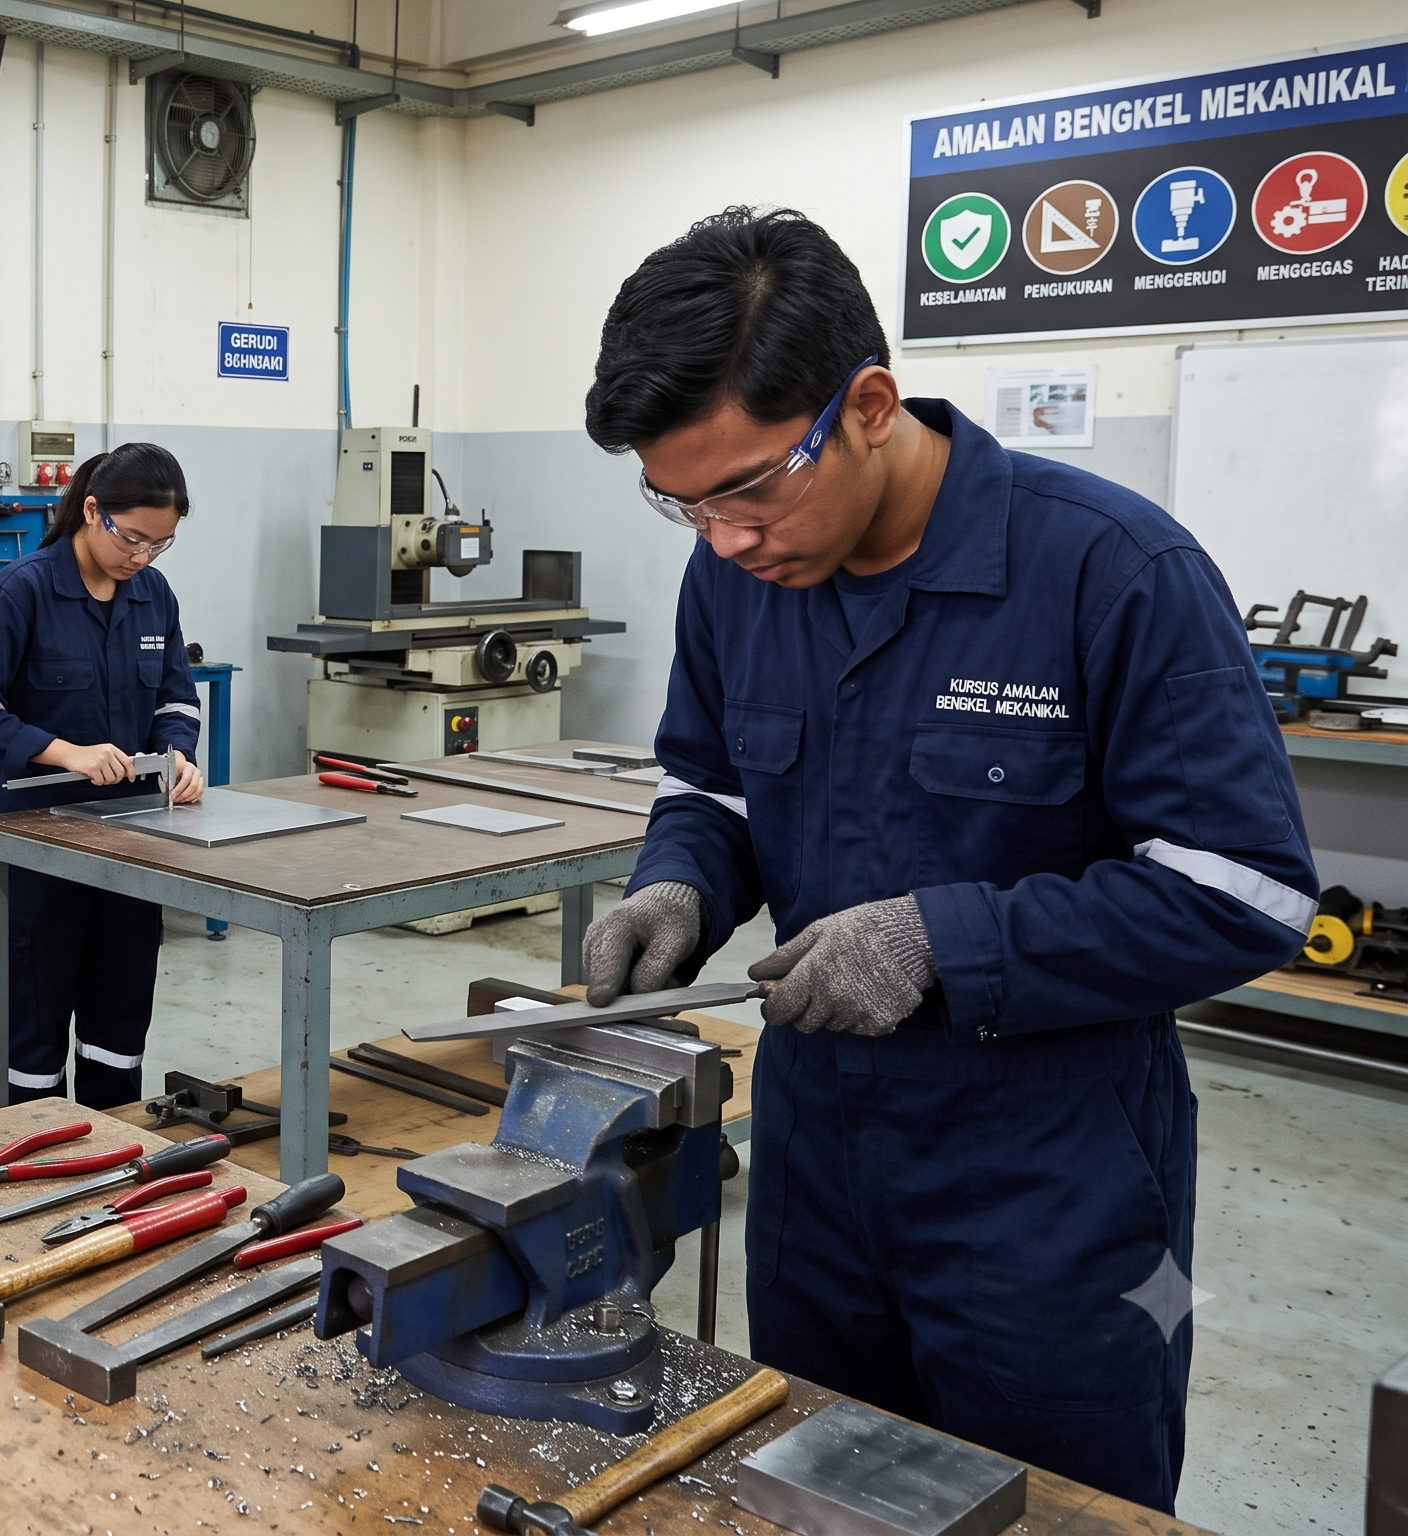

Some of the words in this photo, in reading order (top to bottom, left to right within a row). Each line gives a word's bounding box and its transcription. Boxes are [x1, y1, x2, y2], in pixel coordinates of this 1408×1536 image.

[932, 113, 1046, 159] AMALAN
[1053, 92, 1191, 143] BENGKEL
[1199, 62, 1396, 122] MEKANIKAL
[1133, 269, 1227, 290] MENGGERUDI
[1256, 259, 1354, 281] MENGGEGAS
[920, 287, 1007, 307] KESELAMATAN
[1024, 278, 1113, 299] PENGUKURAN
[230, 332, 278, 351] GERUDI
[949, 678, 999, 696] KURSUS
[1002, 683, 1059, 701] AMALAN
[935, 695, 991, 713] BENGKEL
[995, 700, 1070, 719] MEKANIKAL
